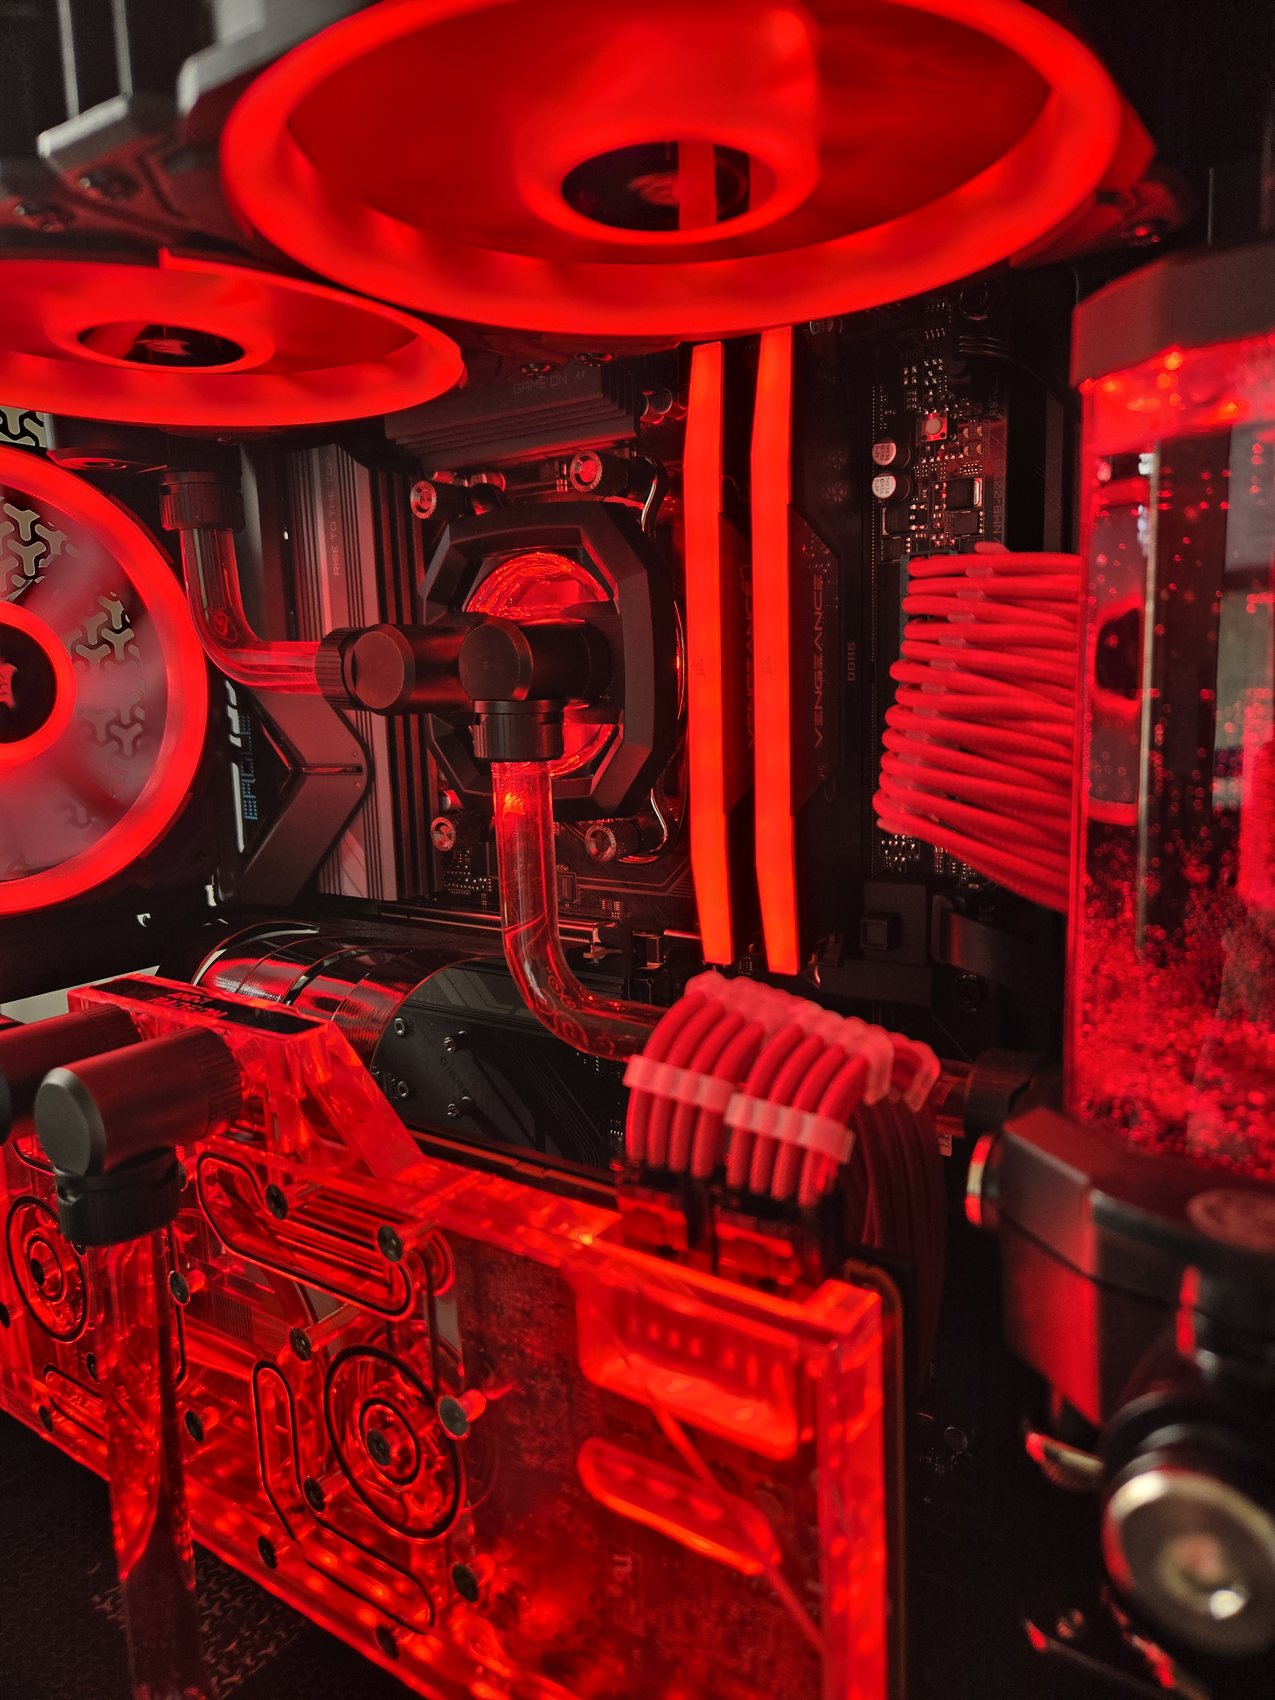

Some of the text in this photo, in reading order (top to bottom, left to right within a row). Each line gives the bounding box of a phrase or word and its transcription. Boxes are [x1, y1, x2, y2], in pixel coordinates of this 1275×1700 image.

[513, 373, 568, 394] GAME ON
[325, 456, 333, 482] TOP
[330, 522, 337, 541] TO
[332, 545, 340, 576] RISE
[813, 573, 824, 749] VENGEANCE
[847, 641, 856, 682] DDR5
[238, 715, 258, 820] EAGLE
